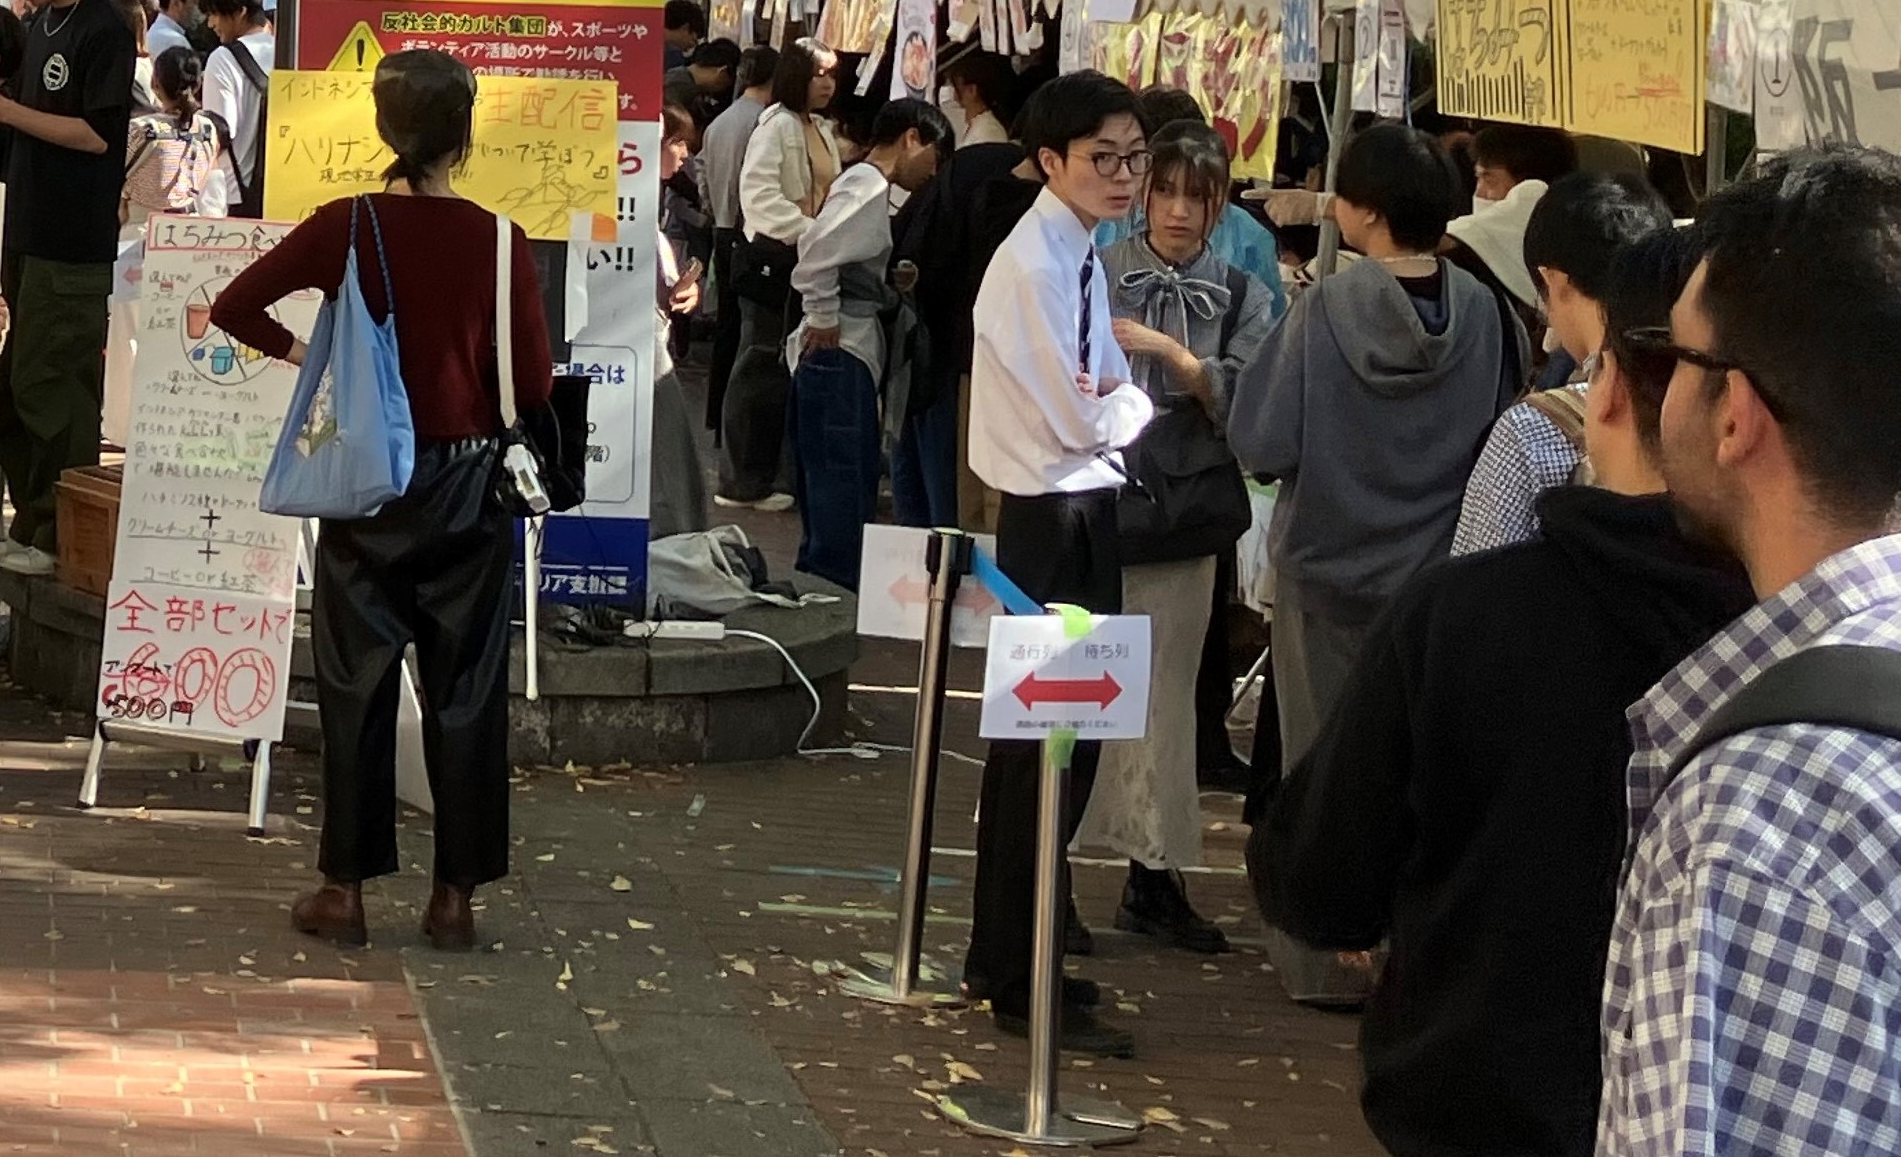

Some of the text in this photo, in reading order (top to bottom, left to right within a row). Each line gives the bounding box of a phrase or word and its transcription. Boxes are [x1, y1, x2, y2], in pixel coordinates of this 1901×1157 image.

[381, 11, 649, 40] 反社会的カルト集団が、スポーツや
[109, 590, 292, 644] 全部セットで
